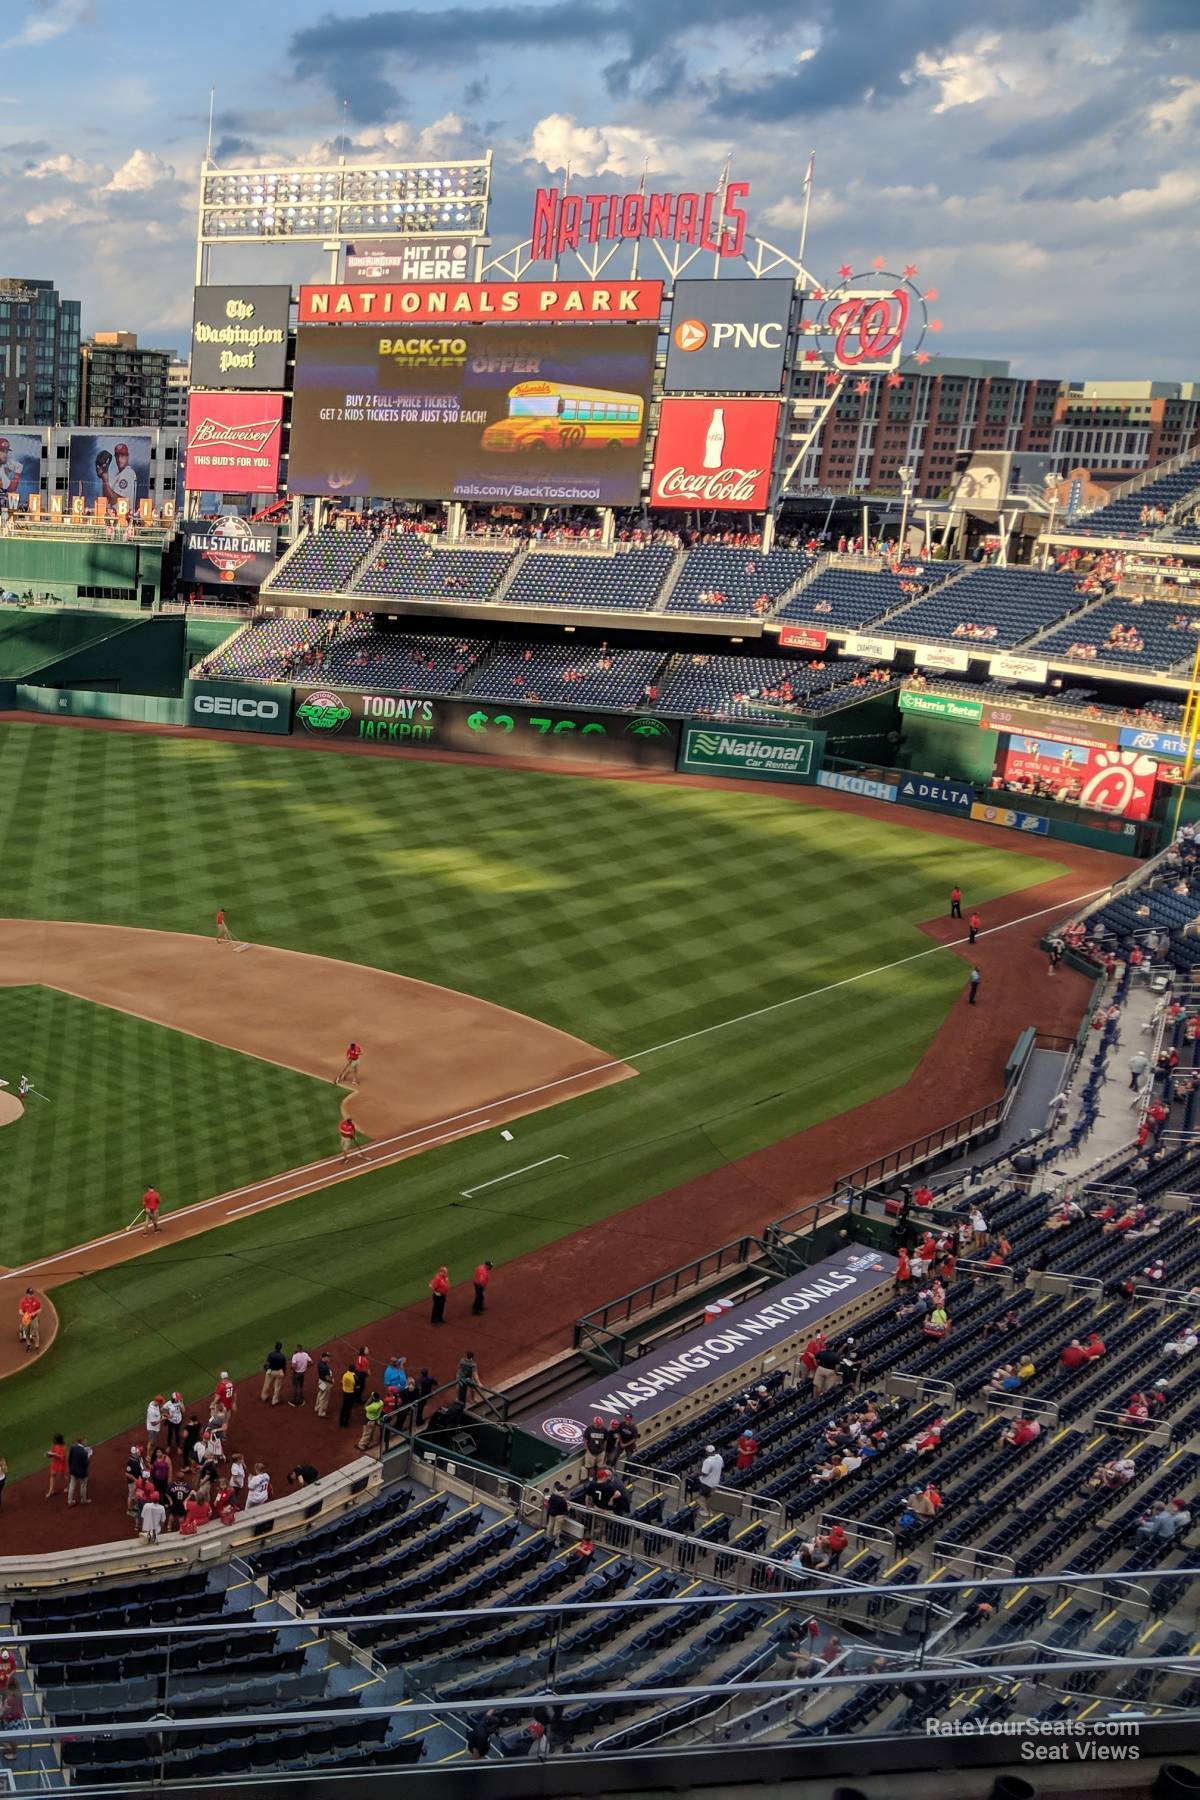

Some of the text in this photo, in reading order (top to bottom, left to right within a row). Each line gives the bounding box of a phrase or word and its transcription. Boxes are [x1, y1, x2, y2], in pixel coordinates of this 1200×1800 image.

[531, 183, 749, 260] NATIONALS
[404, 246, 451, 260] HIT IT
[402, 260, 467, 280] HERE
[226, 299, 255, 320] The
[310, 288, 640, 314] NATIONALS PARK
[195, 321, 284, 347] Washington
[711, 323, 783, 349] PNC
[379, 339, 467, 355] BACK-TO
[220, 350, 255, 372] Post
[472, 357, 541, 374] OFFER
[346, 395, 461, 410] BUY 2 FULL-PRICE TICKETS,
[320, 409, 487, 424] GET 2 KIDS TICKETS FOR JUST $10 EACH!
[196, 425, 271, 442] Budweiser
[194, 456, 272, 467] THIS BUD'S FOR YOU.
[657, 467, 765, 501] Coca-Cola
[189, 535, 271, 553] ALL STAR GAME
[194, 695, 279, 719] GEICO
[296, 703, 351, 720] 50/50
[362, 696, 433, 721] TODAY'S
[913, 698, 980, 719] Harris Teeter
[991, 712, 1011, 722] 6:30
[360, 720, 434, 739] JACKPOT
[718, 740, 803, 762] National
[745, 758, 798, 770] Car Rental
[835, 775, 891, 800] KOCH
[919, 783, 969, 805] DELTA
[589, 1271, 857, 1416] WASHINGTON NATIONALS
